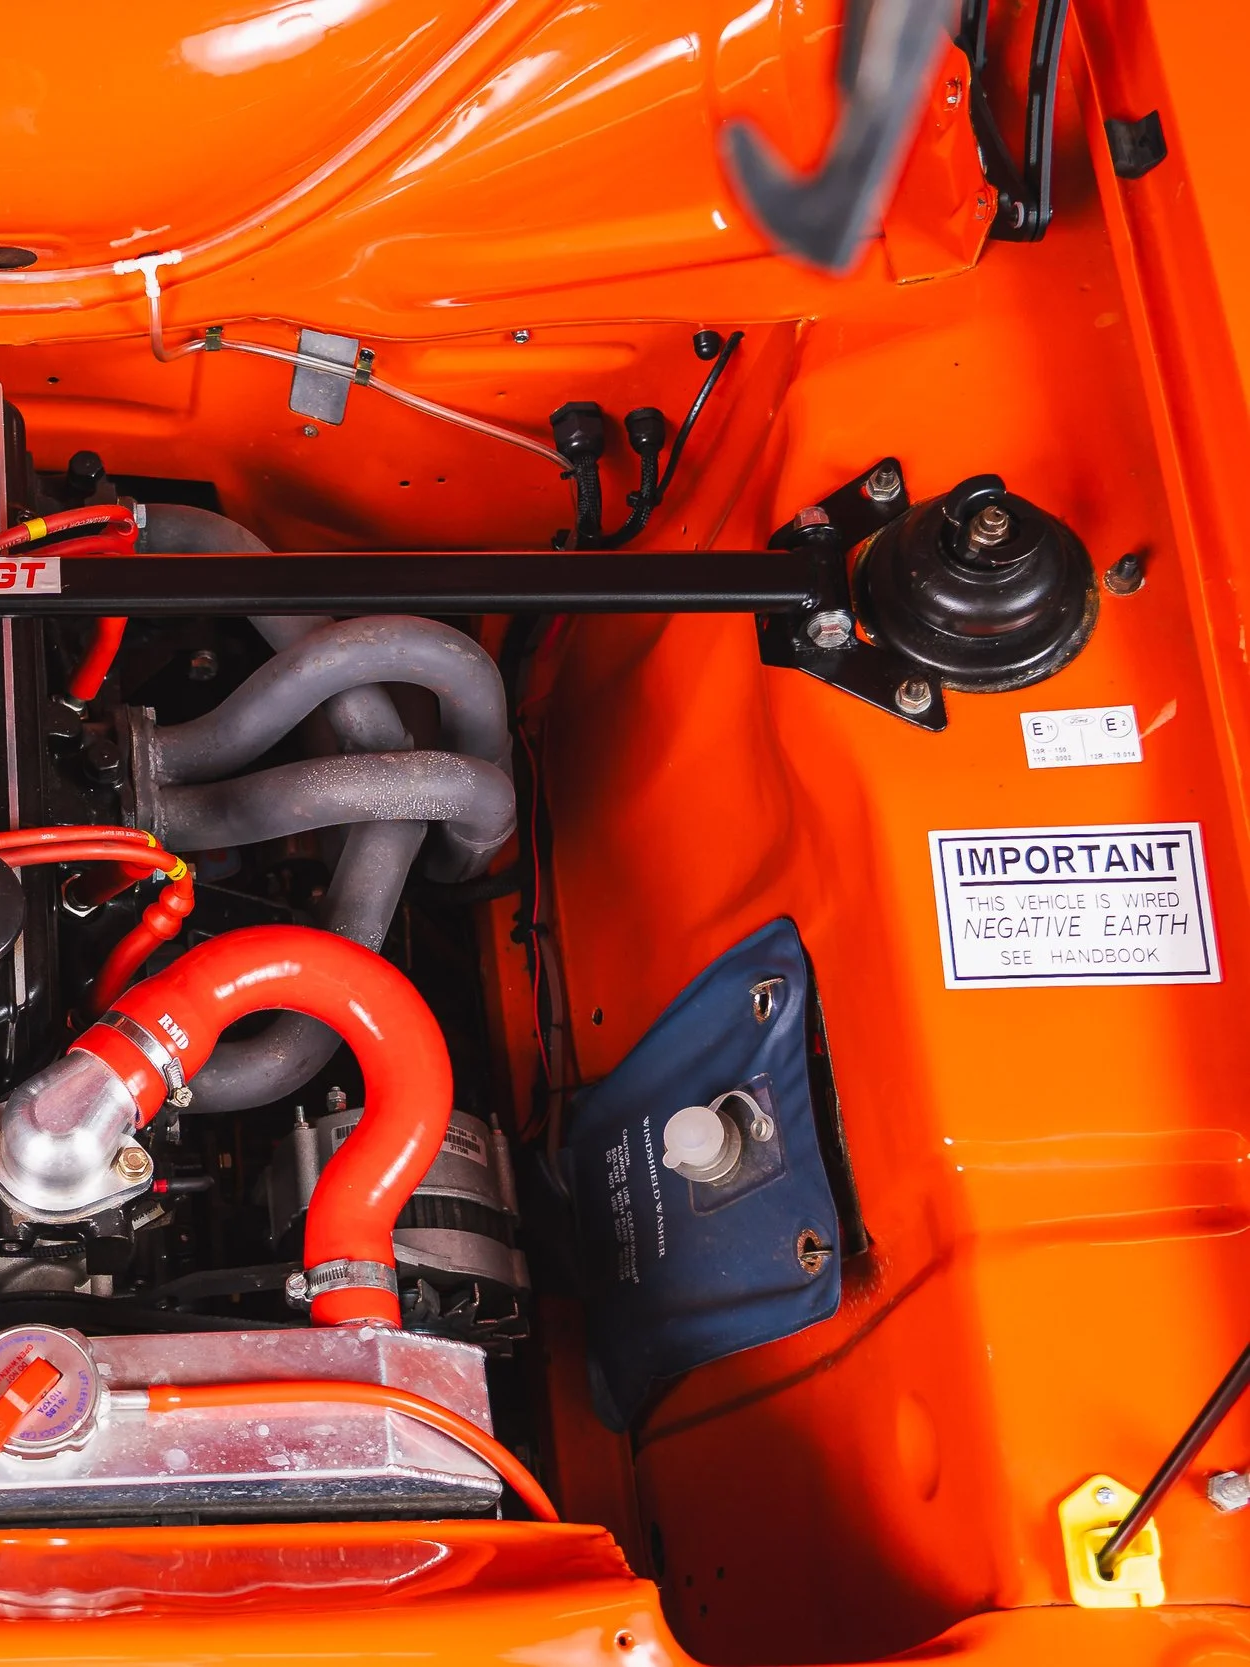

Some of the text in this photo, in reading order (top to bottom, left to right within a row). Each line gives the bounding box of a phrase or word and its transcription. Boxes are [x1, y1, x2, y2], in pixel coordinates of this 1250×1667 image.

[1032, 722, 1044, 736] E
[1105, 718, 1118, 731] E
[955, 842, 1181, 876] IMPORTANT
[965, 892, 1180, 912] THIS VEHICLE IS WIRED
[964, 913, 1188, 939] NEGATIVE EARTH
[1000, 948, 1160, 965] SEE HANDBOOK
[157, 1012, 190, 1051] RMD
[605, 1150, 612, 1163] DO
[611, 1147, 620, 1184] SOLENT
[616, 1190, 625, 1215] WITH
[617, 1145, 627, 1183] ALWAYS
[623, 1186, 631, 1206] USE
[643, 1115, 666, 1259] WINDSHIELD WASHER
[17, 1343, 34, 1360] OPEN
[0, 1358, 18, 1378] WHEN
[6, 1361, 28, 1384] DO NOT
[37, 1388, 62, 1414] 110 KPA
[45, 1396, 68, 1419] 16 LBS
